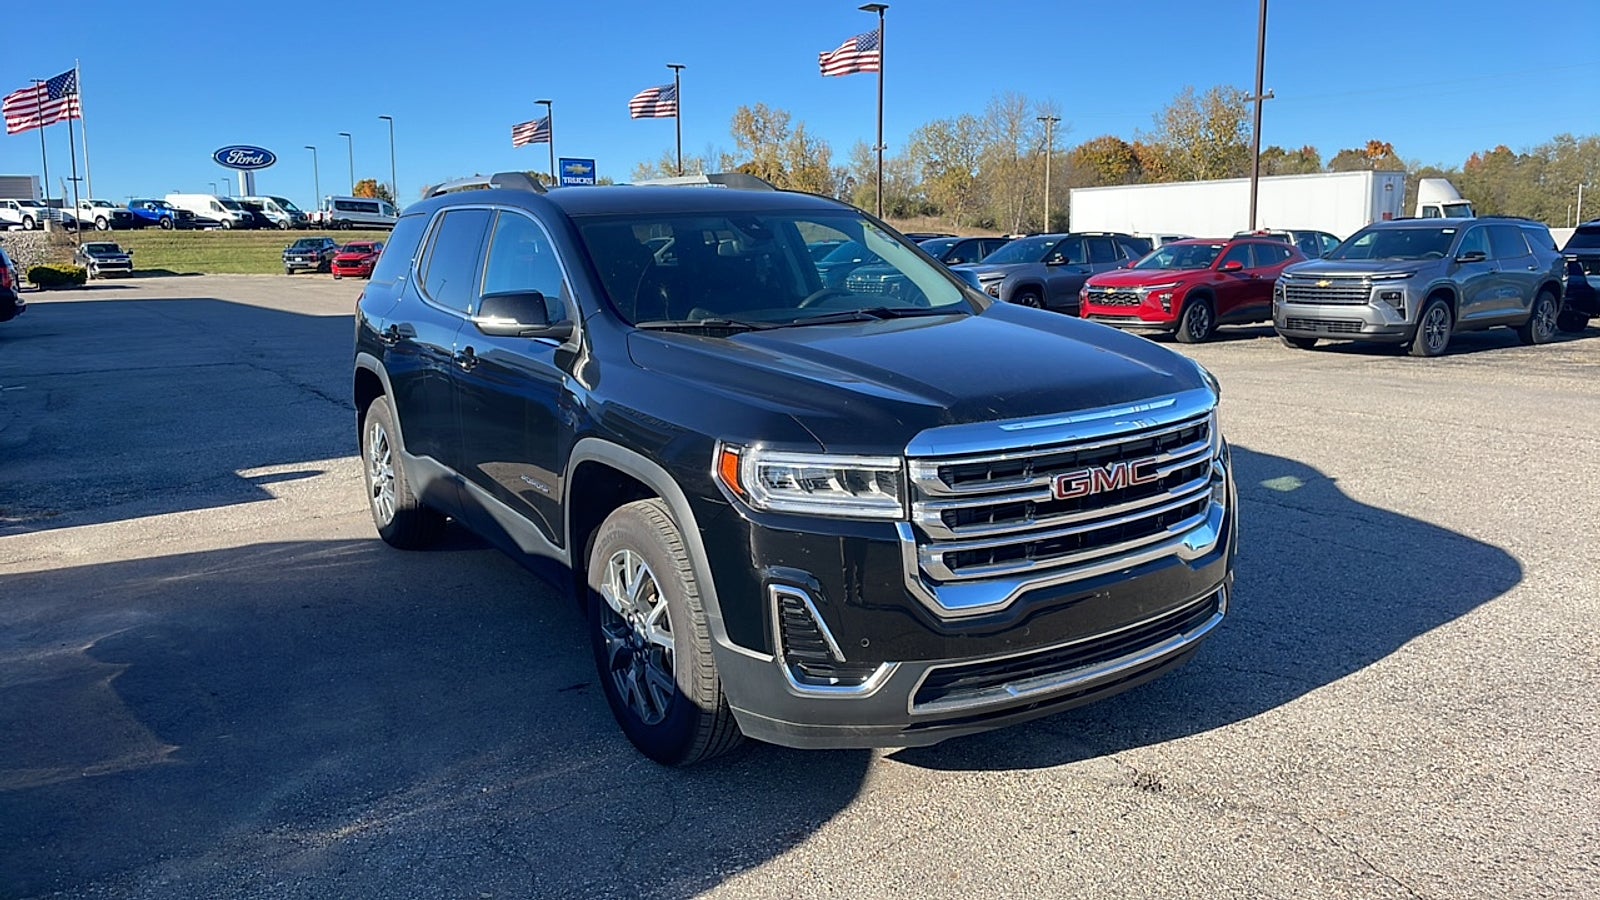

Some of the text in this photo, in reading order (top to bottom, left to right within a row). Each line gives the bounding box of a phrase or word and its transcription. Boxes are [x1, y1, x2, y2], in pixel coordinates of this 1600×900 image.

[226, 150, 264, 164] Ford
[562, 177, 594, 185] TRUCKS
[1053, 457, 1159, 500] GMC
